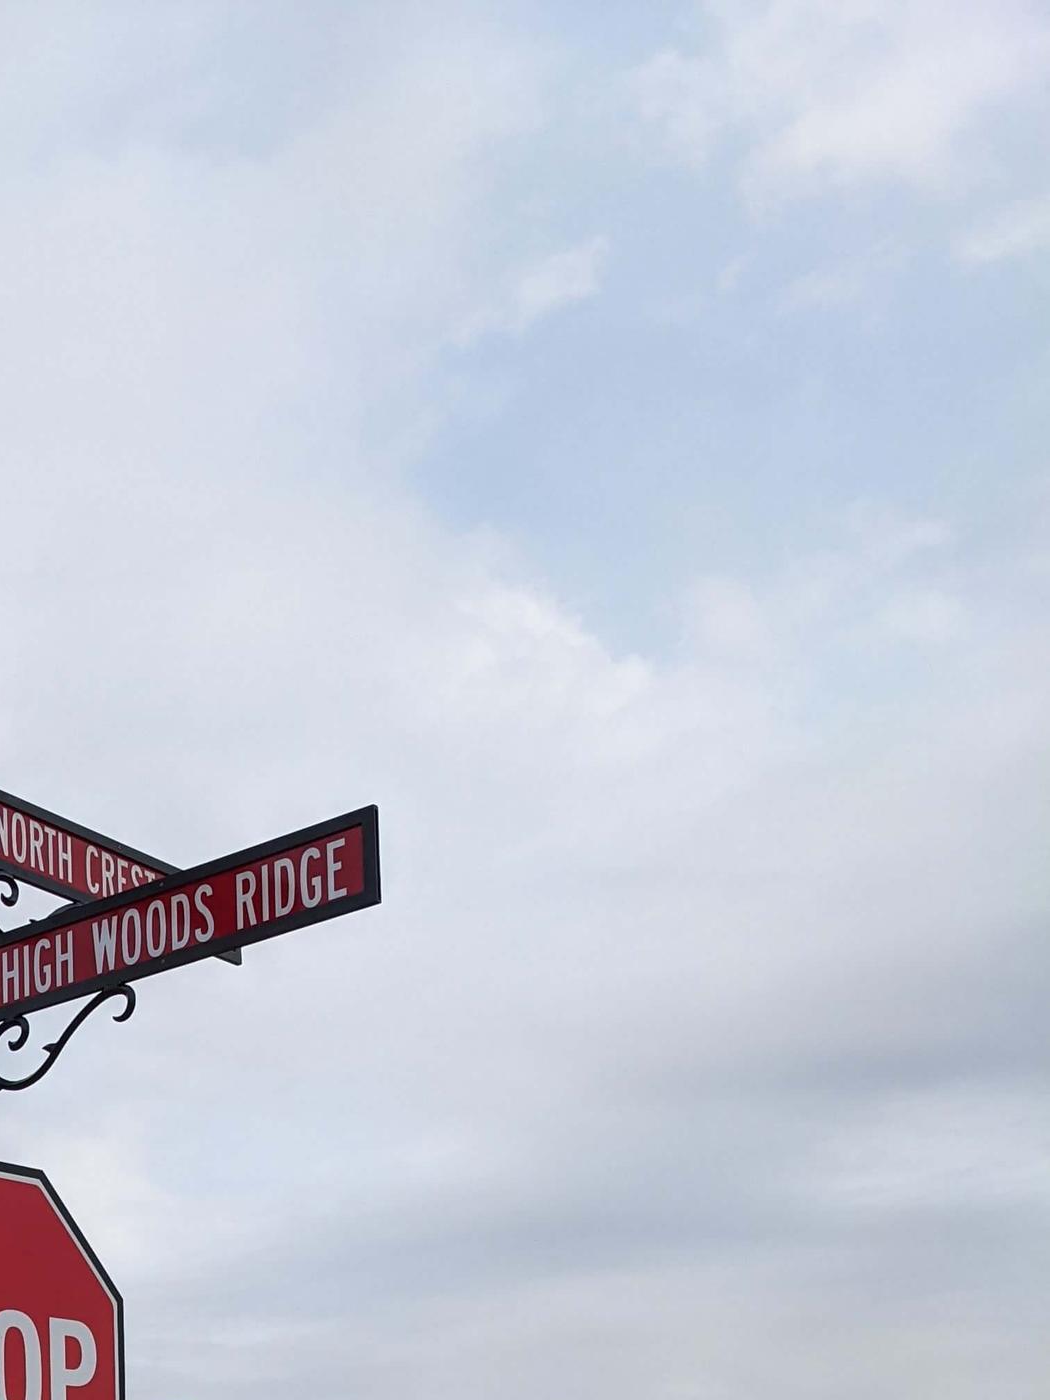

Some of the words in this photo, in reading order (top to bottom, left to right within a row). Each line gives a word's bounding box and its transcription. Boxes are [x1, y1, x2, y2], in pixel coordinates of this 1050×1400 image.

[1, 931, 75, 1004] HIGH
[92, 883, 215, 975] WOODS
[235, 838, 348, 931] RIDGE
[85, 845, 156, 898] CRES
